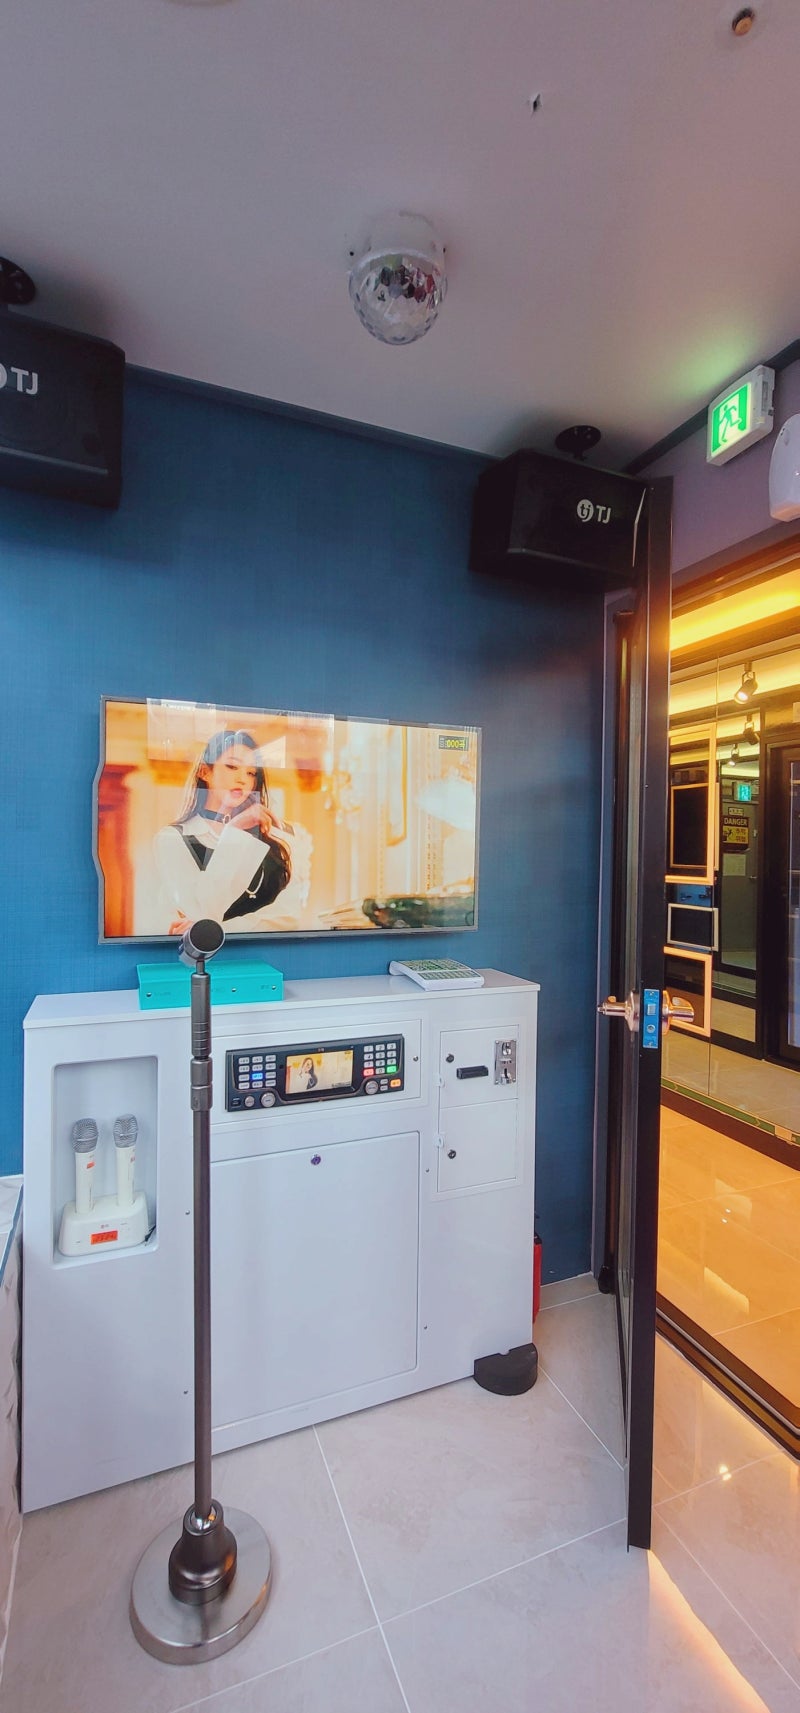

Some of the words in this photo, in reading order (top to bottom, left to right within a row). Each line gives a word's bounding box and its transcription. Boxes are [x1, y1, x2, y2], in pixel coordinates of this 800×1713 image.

[10, 366, 38, 395] TJ
[596, 504, 611, 524] TJ
[723, 817, 748, 826] DANGER
